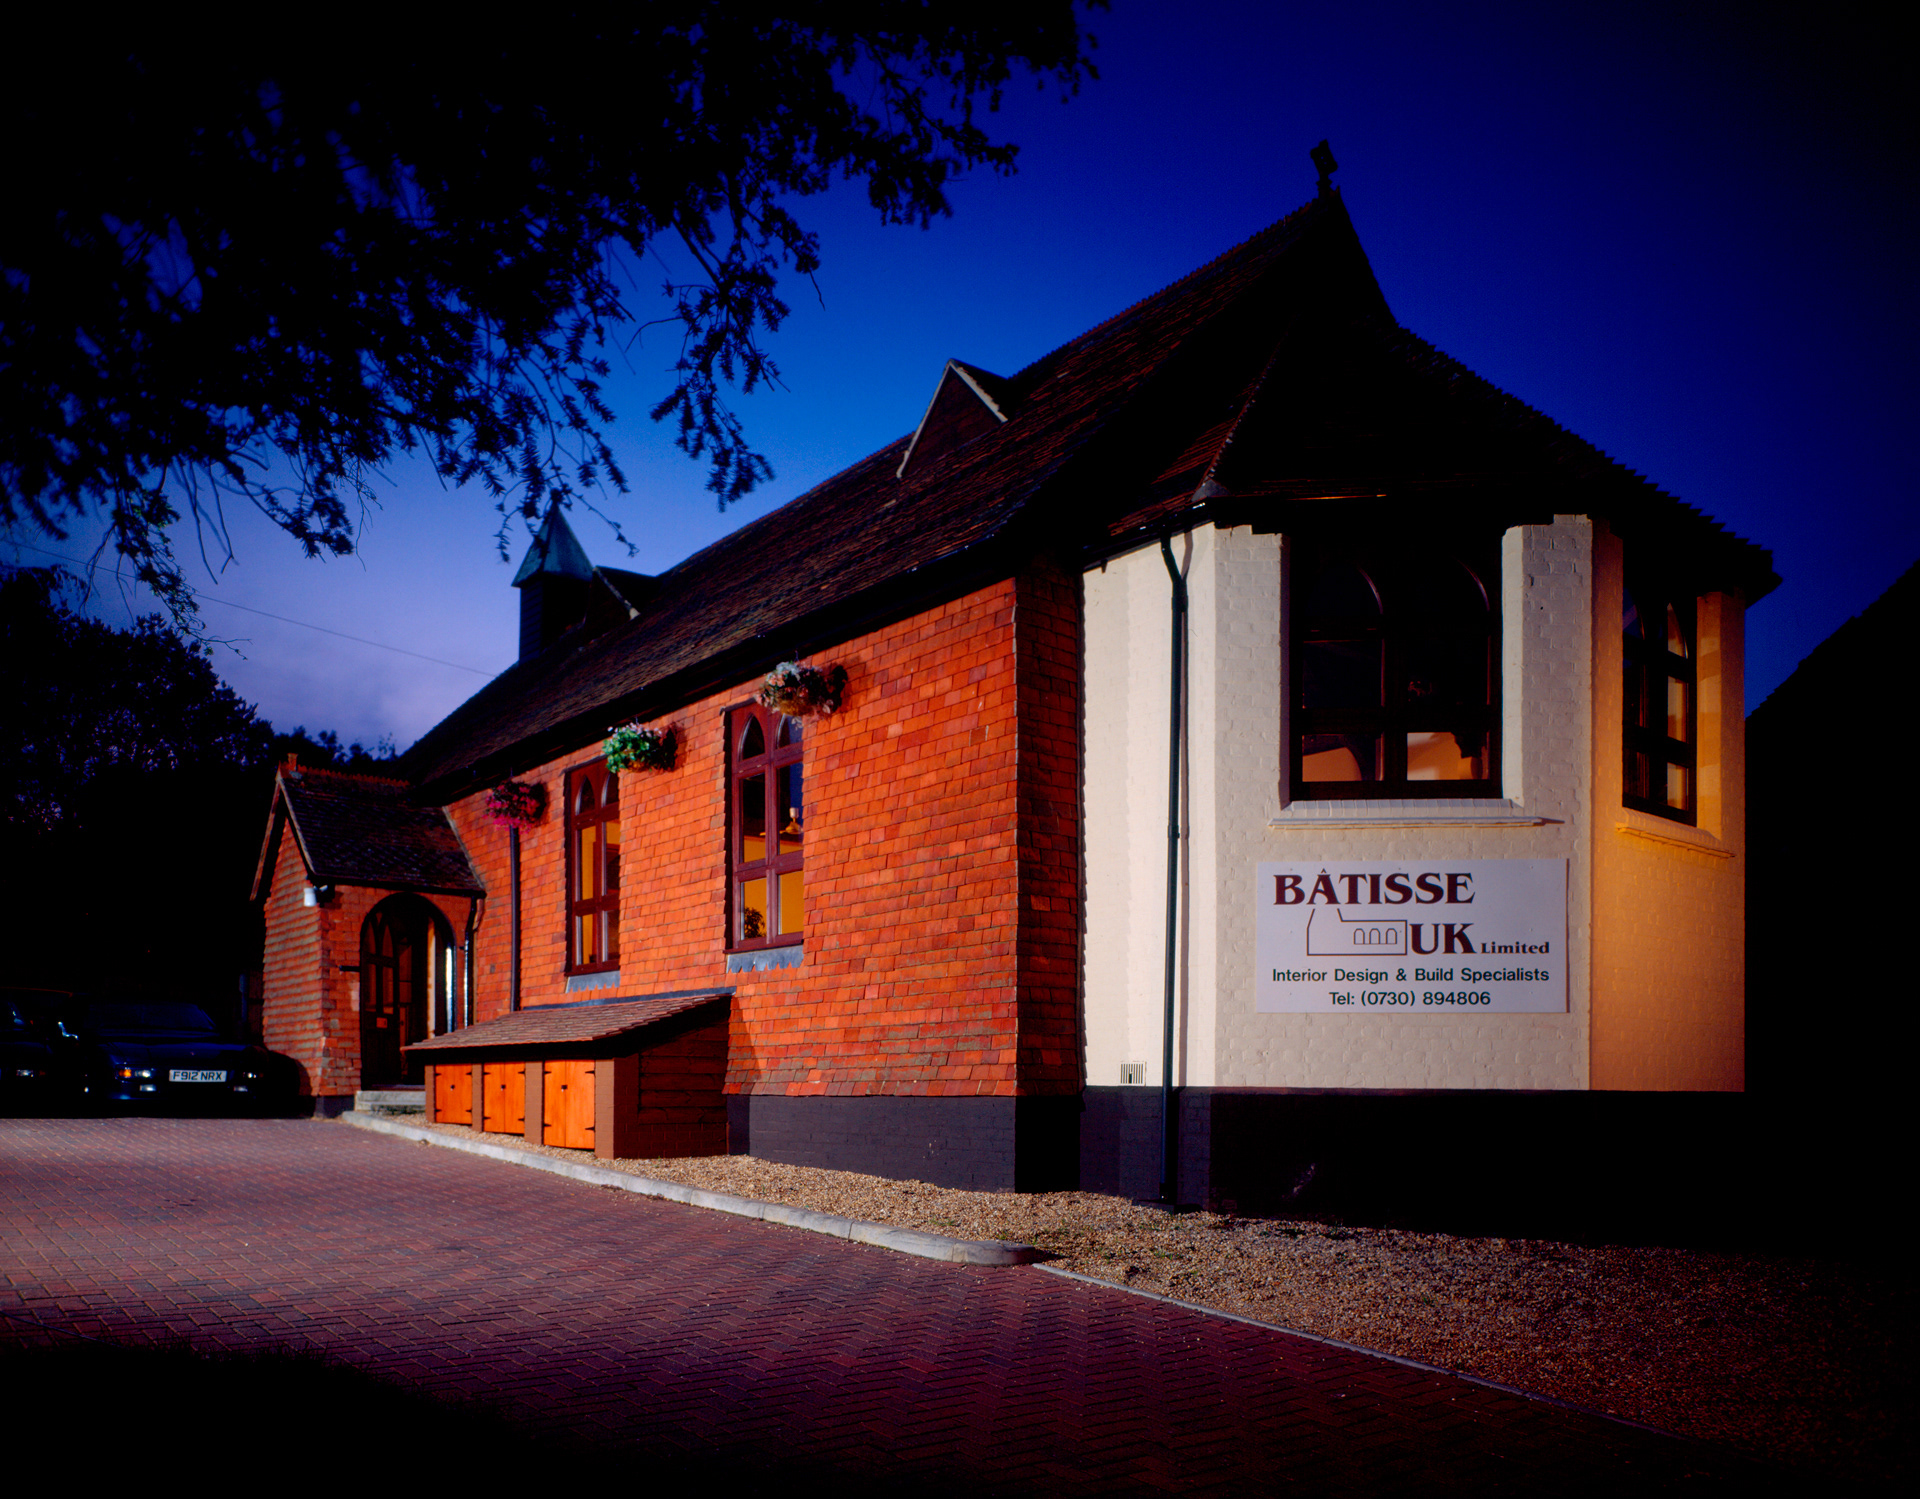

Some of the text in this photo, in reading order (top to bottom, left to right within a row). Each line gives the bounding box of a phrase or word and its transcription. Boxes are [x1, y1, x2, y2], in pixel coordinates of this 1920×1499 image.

[1273, 868, 1476, 905] BÂTISSE
[1409, 923, 1550, 955] UK Limited
[1272, 968, 1549, 984] Interior Design & Build Specialists
[1329, 990, 1491, 1006] Tel: (0730) 894806
[173, 1071, 223, 1081] F912 NRX
